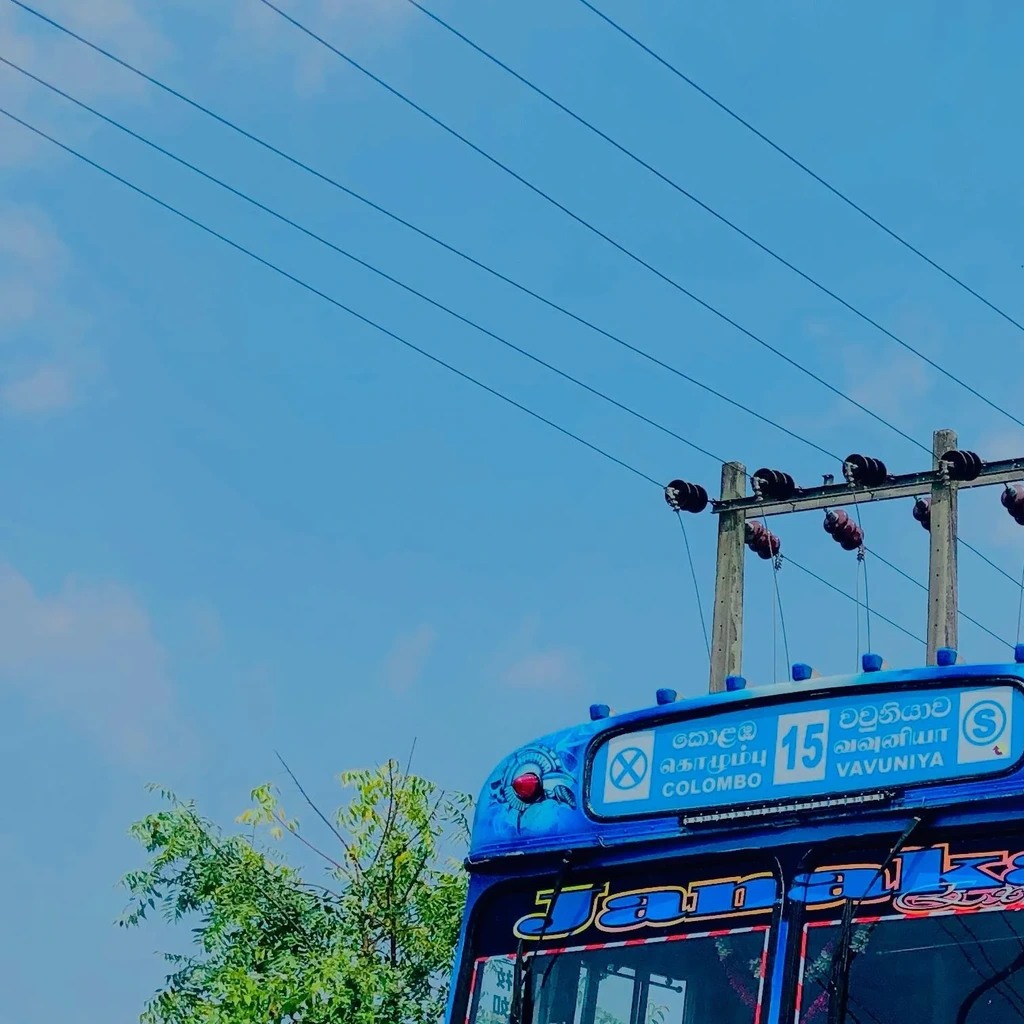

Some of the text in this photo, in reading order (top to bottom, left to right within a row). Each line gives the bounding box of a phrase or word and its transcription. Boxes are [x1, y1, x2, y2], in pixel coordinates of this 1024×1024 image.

[838, 695, 951, 732] වවුනියාව
[672, 720, 758, 749] කොළඹ
[781, 723, 825, 771] 15
[833, 726, 951, 754] வவுனியா
[660, 744, 767, 775] கொழும்பு
[836, 751, 945, 778] VAVUNIYA
[662, 772, 762, 798] COLOMBO
